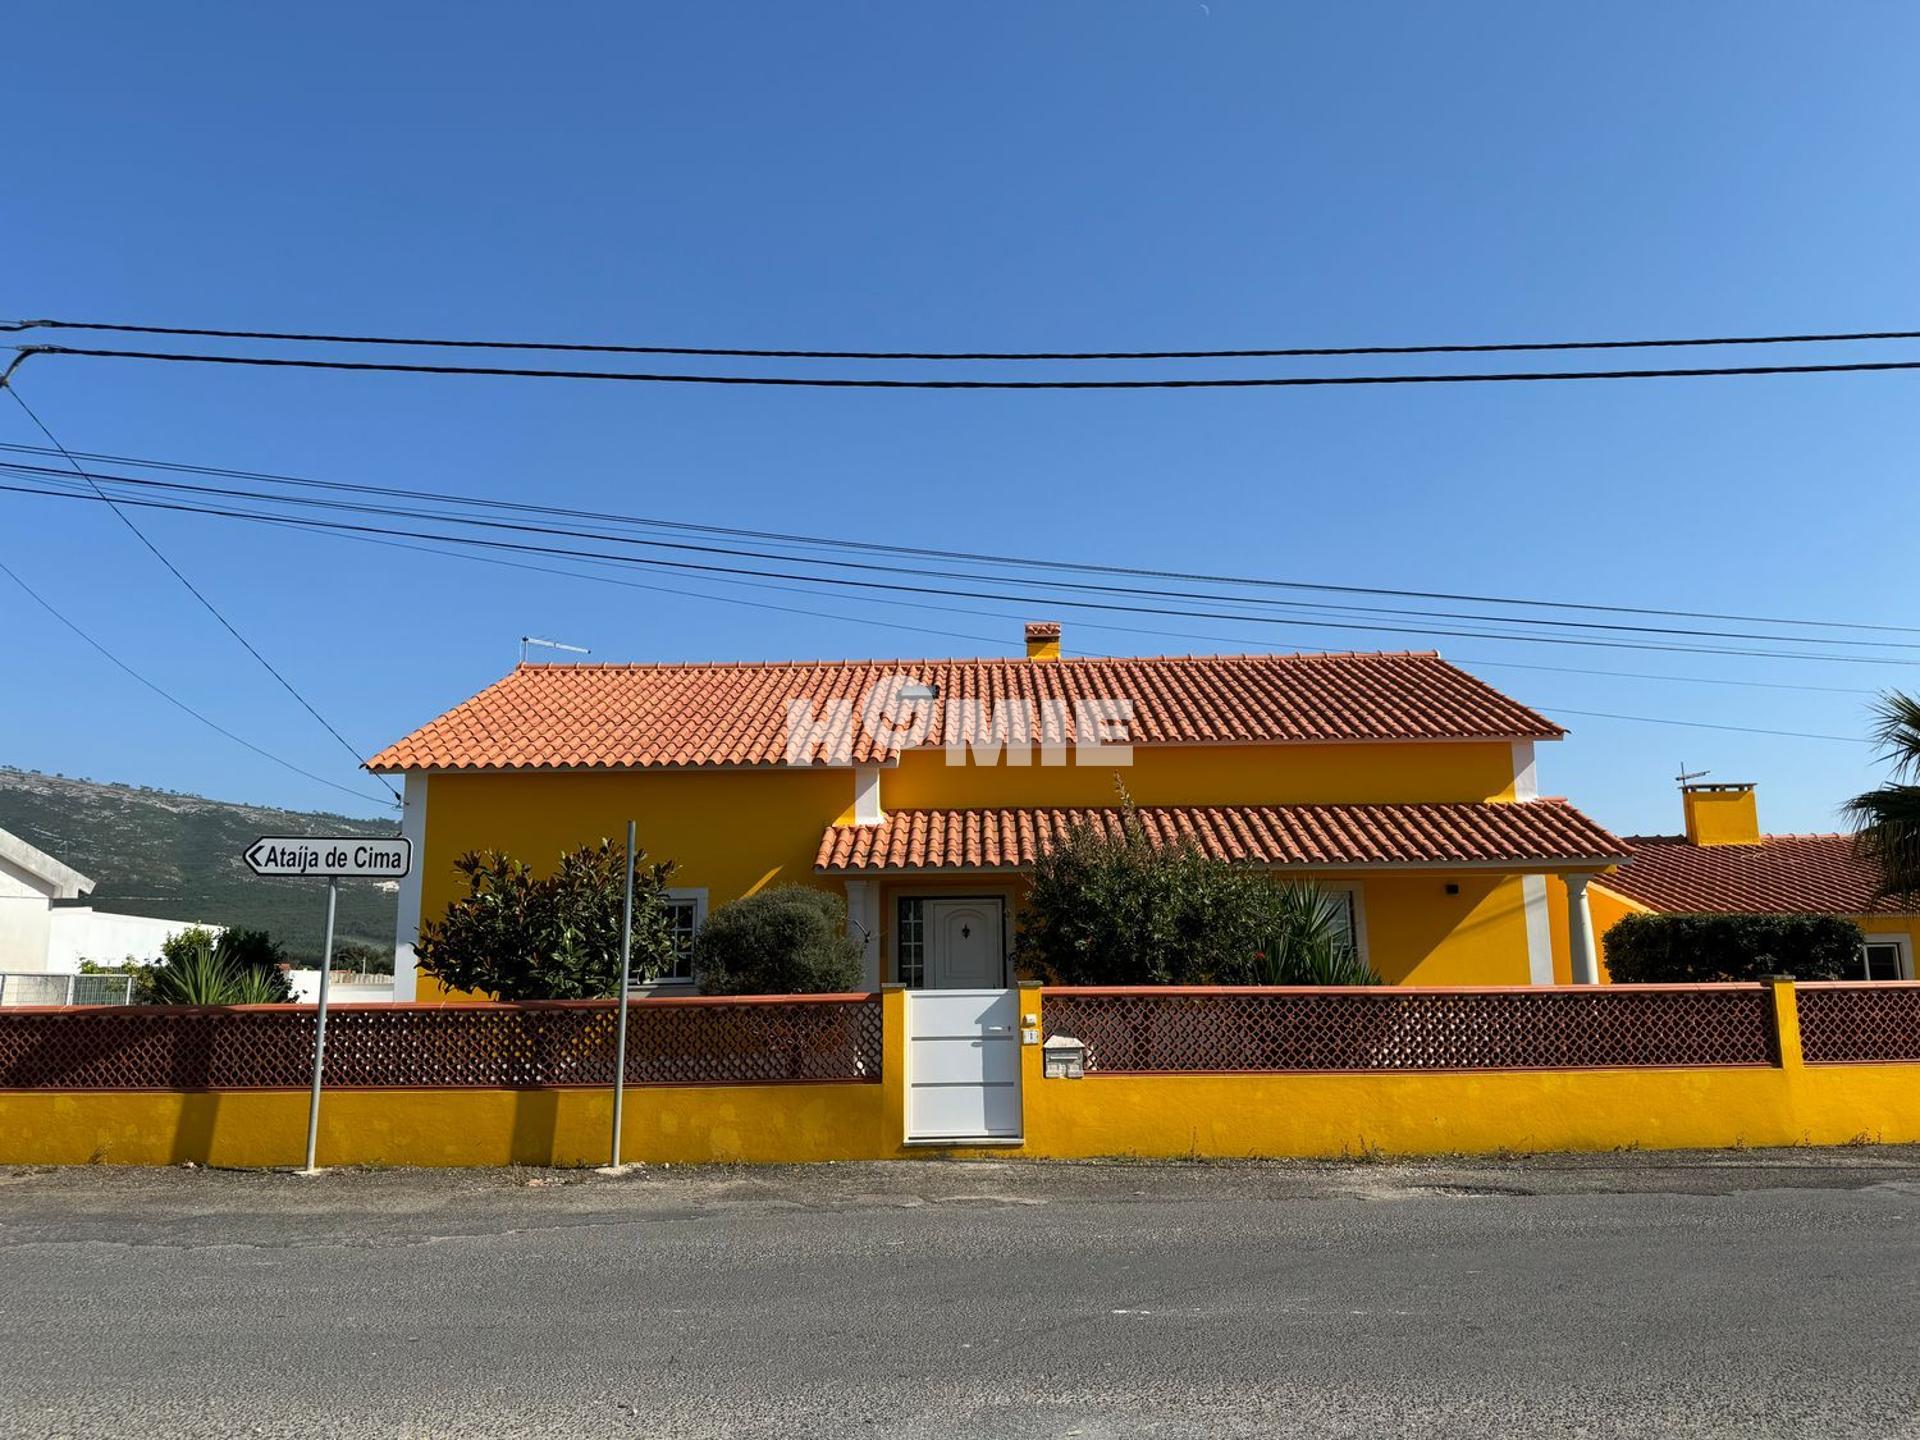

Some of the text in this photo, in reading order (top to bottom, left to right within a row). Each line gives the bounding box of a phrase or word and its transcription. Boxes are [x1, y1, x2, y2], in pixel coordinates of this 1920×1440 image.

[264, 845, 401, 873] Ataíja de Cima
